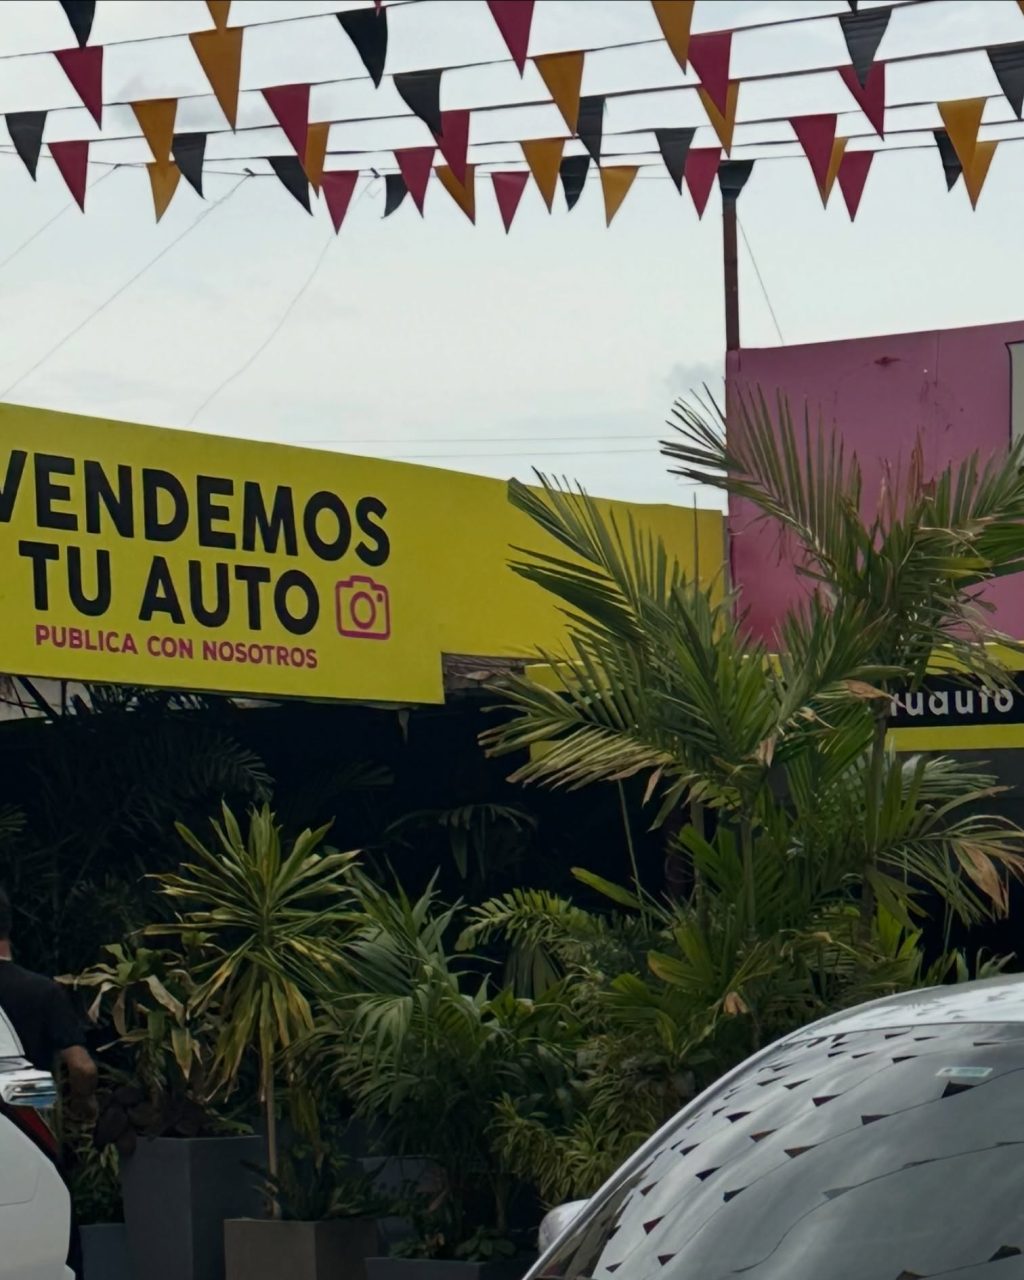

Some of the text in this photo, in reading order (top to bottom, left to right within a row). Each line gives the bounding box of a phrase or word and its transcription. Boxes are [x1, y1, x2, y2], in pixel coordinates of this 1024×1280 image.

[0, 449, 391, 567] VENDEMOS
[18, 540, 320, 635] TU AUTO
[35, 625, 319, 669] PUBLICA CON NOSOTROS
